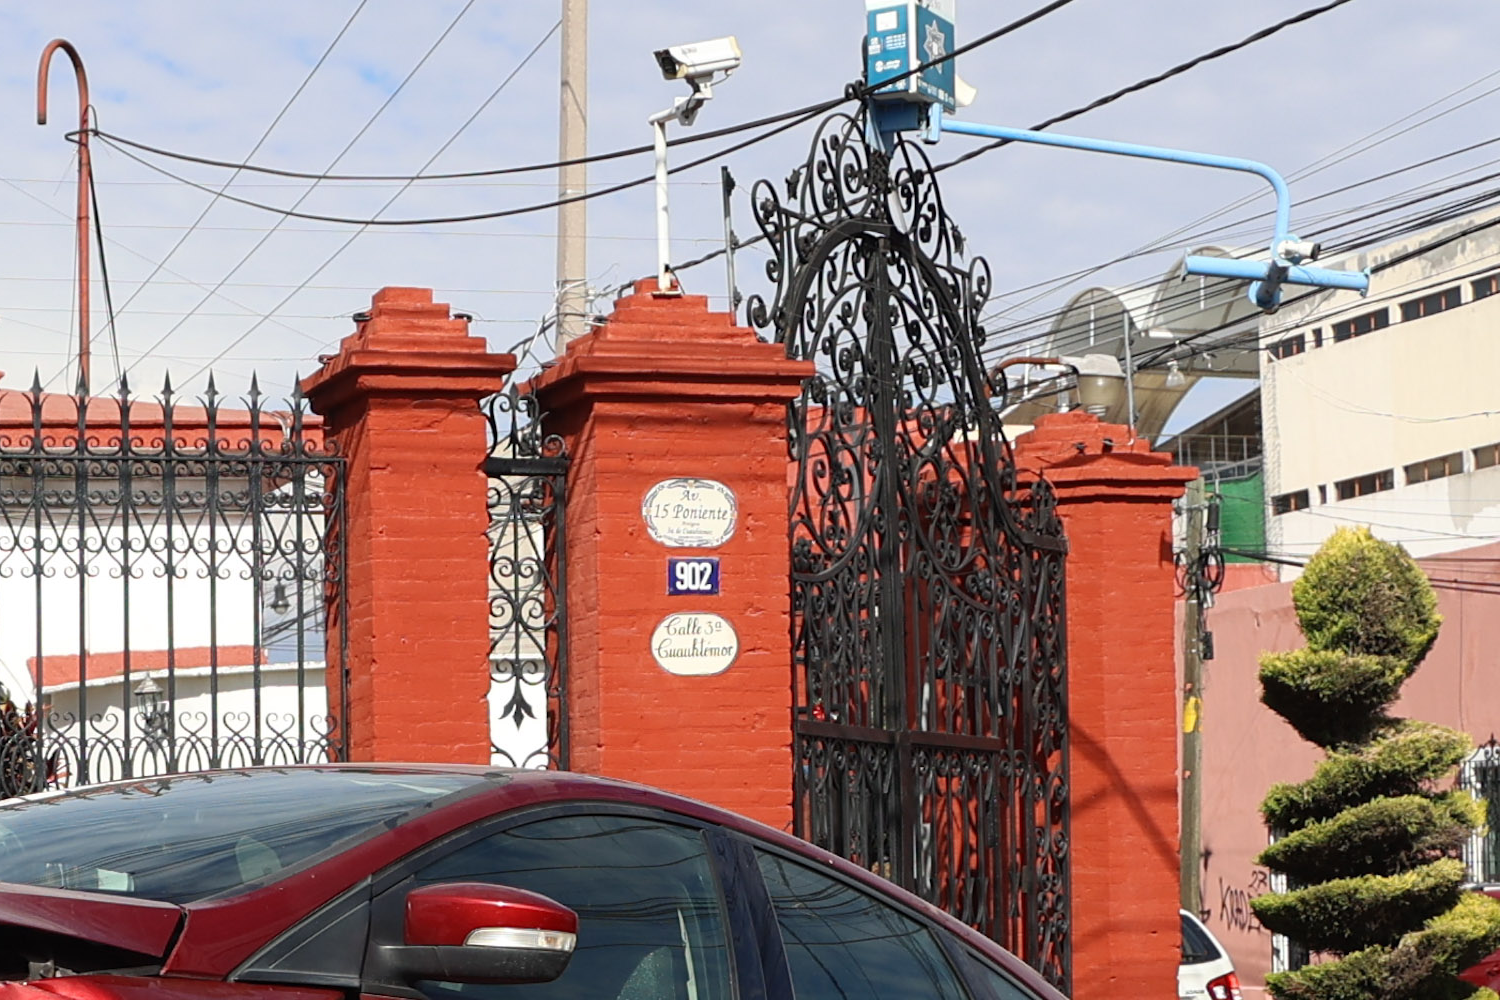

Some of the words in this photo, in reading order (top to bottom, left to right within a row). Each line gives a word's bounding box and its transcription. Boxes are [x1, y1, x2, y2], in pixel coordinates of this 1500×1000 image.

[680, 489, 702, 501] Av.
[653, 503, 671, 519] 15
[671, 503, 728, 521] Poniente
[675, 561, 712, 591] 902
[664, 617, 702, 636] Calle
